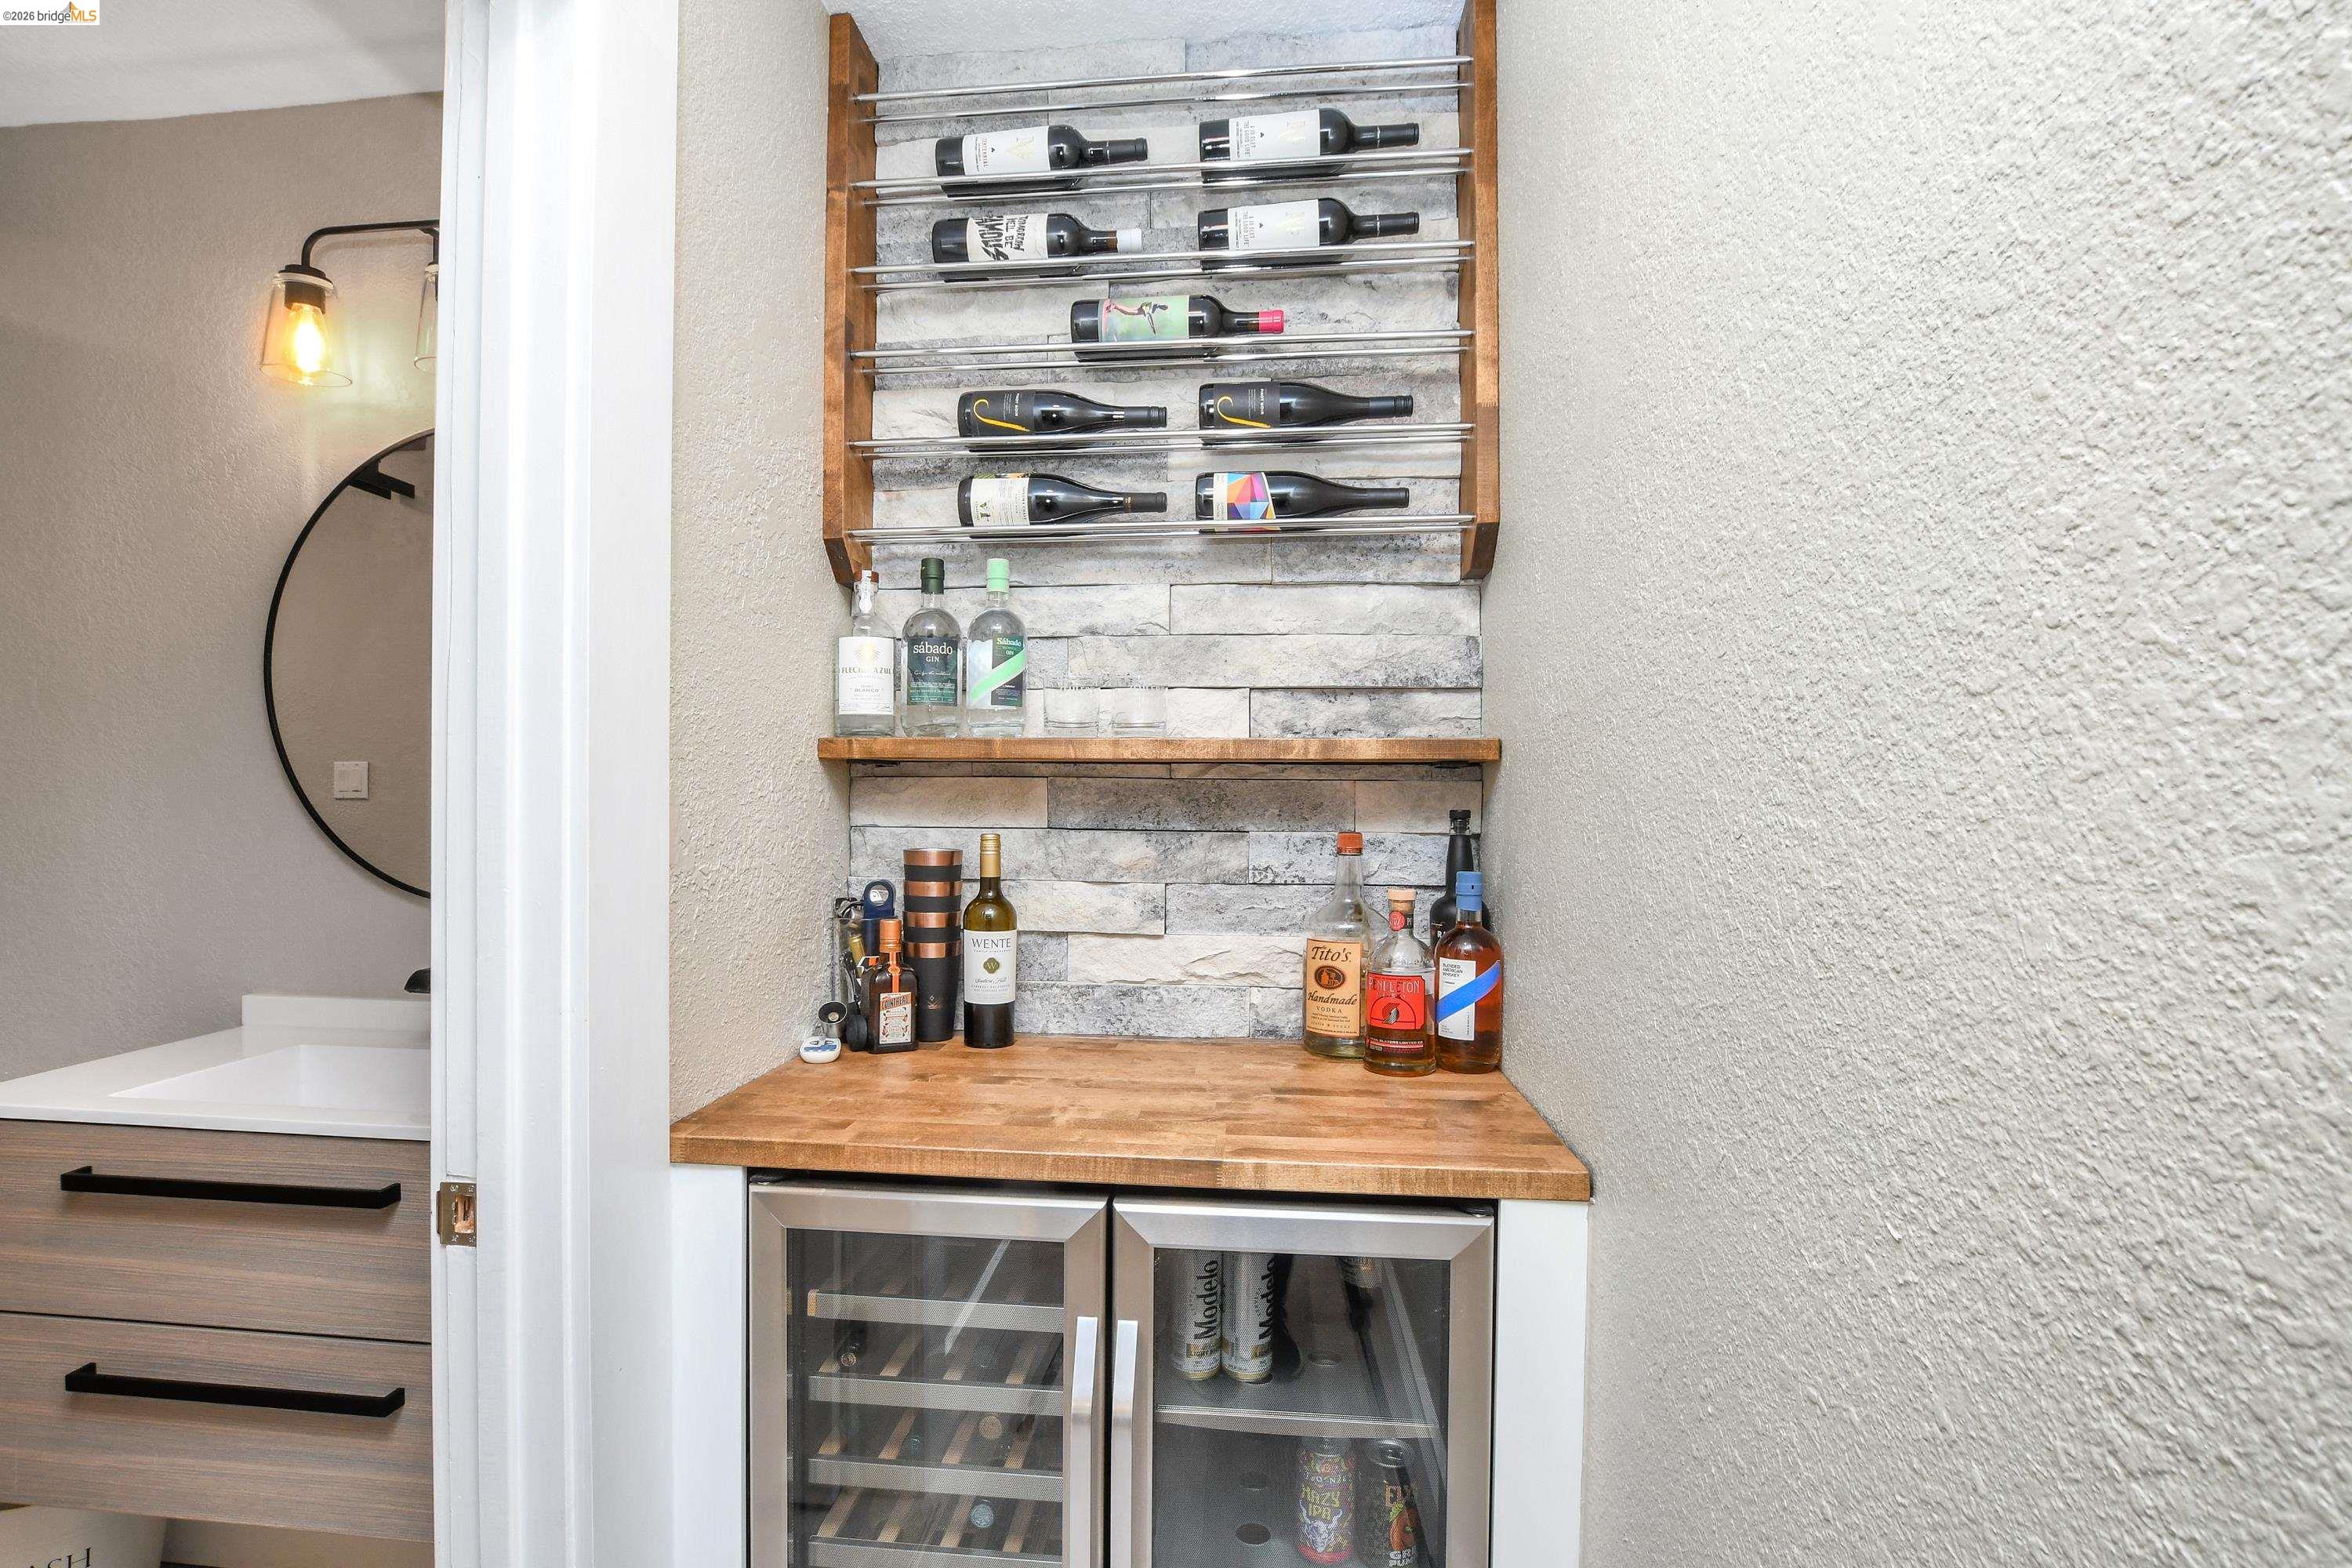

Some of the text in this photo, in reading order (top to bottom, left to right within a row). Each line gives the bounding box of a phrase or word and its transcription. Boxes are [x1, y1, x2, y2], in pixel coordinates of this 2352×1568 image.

[1013, 216, 1029, 252] TOMORROW
[1005, 235, 1014, 249] BE
[913, 641, 953, 655] sábado
[996, 637, 1022, 648] Sábado
[971, 938, 1011, 949] WENTE
[1308, 990, 1358, 1005] Handmade
[1194, 1259, 1219, 1340] Modelo
